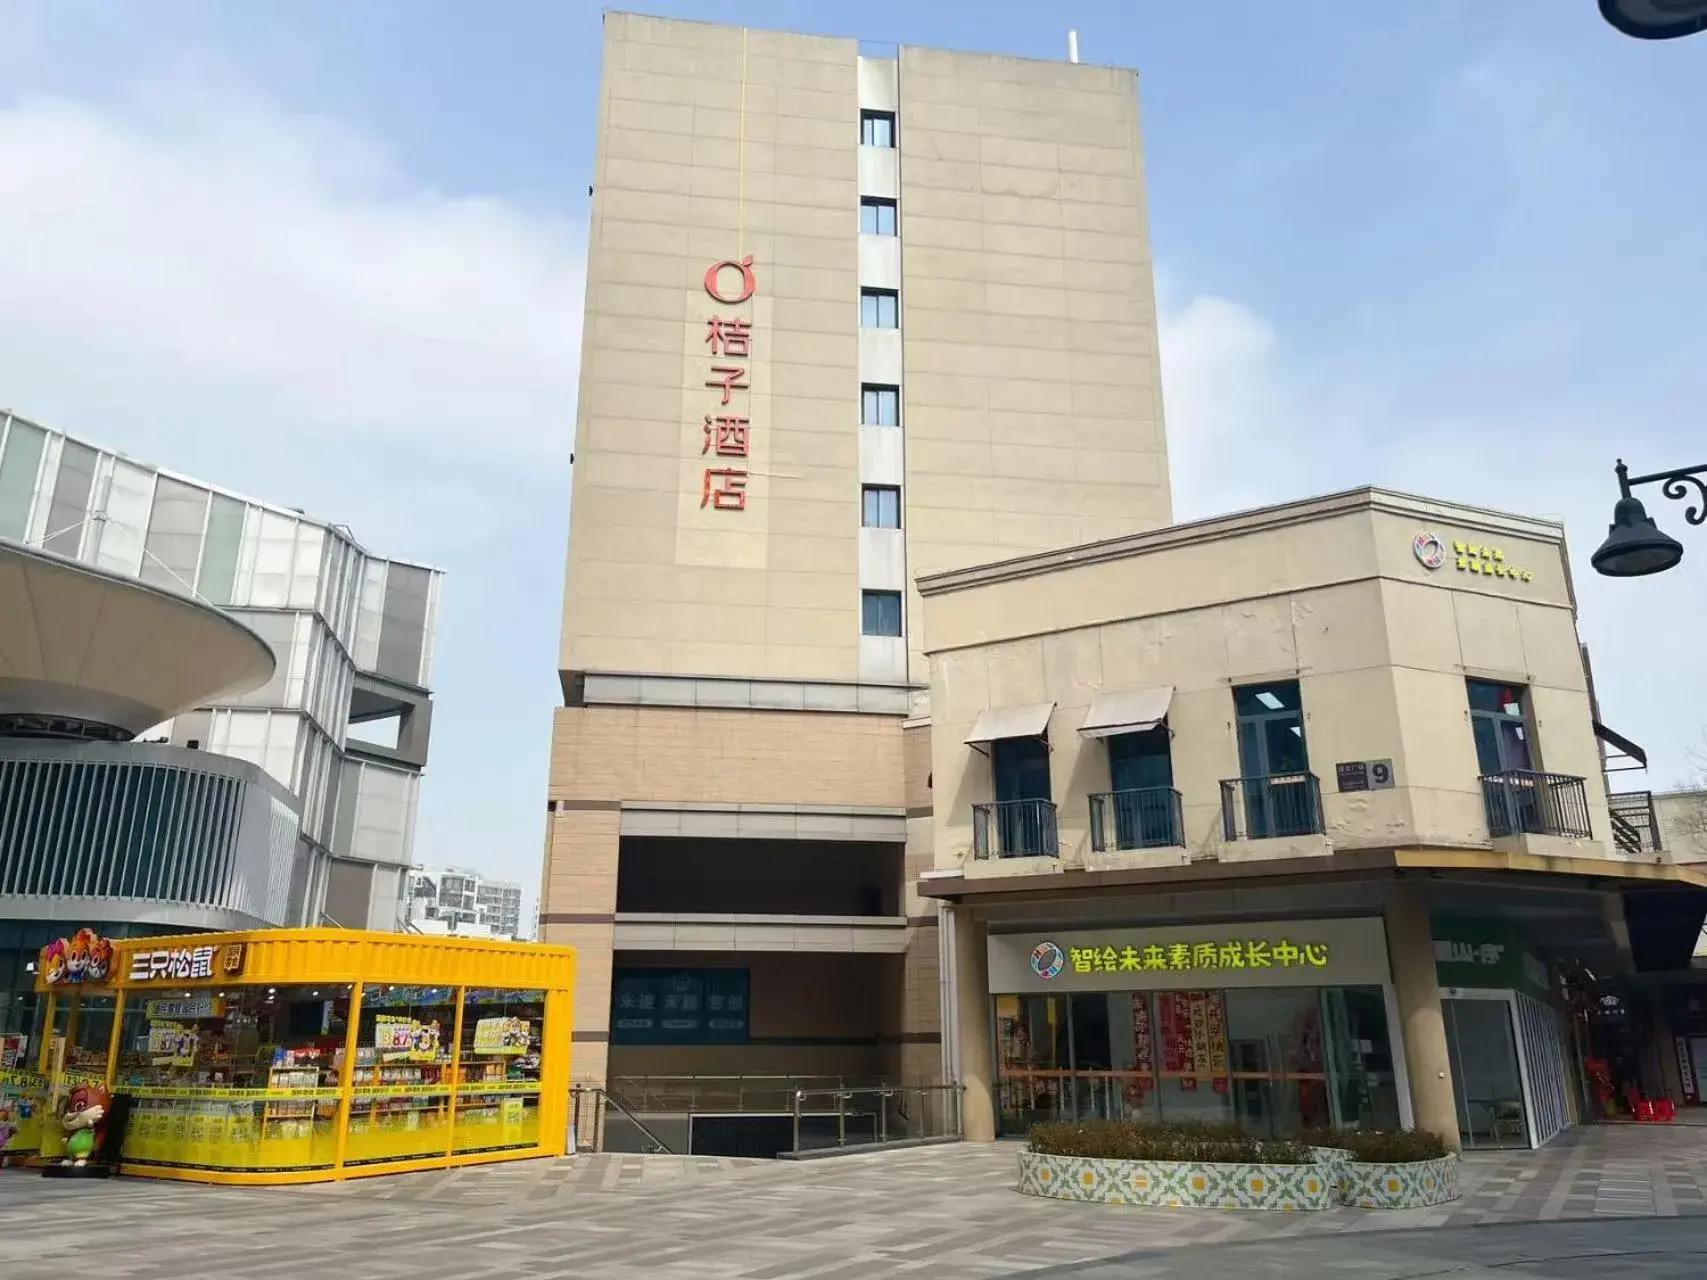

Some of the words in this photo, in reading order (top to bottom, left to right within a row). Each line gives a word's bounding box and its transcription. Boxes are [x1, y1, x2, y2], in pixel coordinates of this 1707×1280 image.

[701, 316, 752, 511] 桔子酒店
[1372, 763, 1390, 784] 9
[129, 946, 214, 980] 三只松鼠
[1069, 940, 1328, 973] 智绘未来素质成长中心
